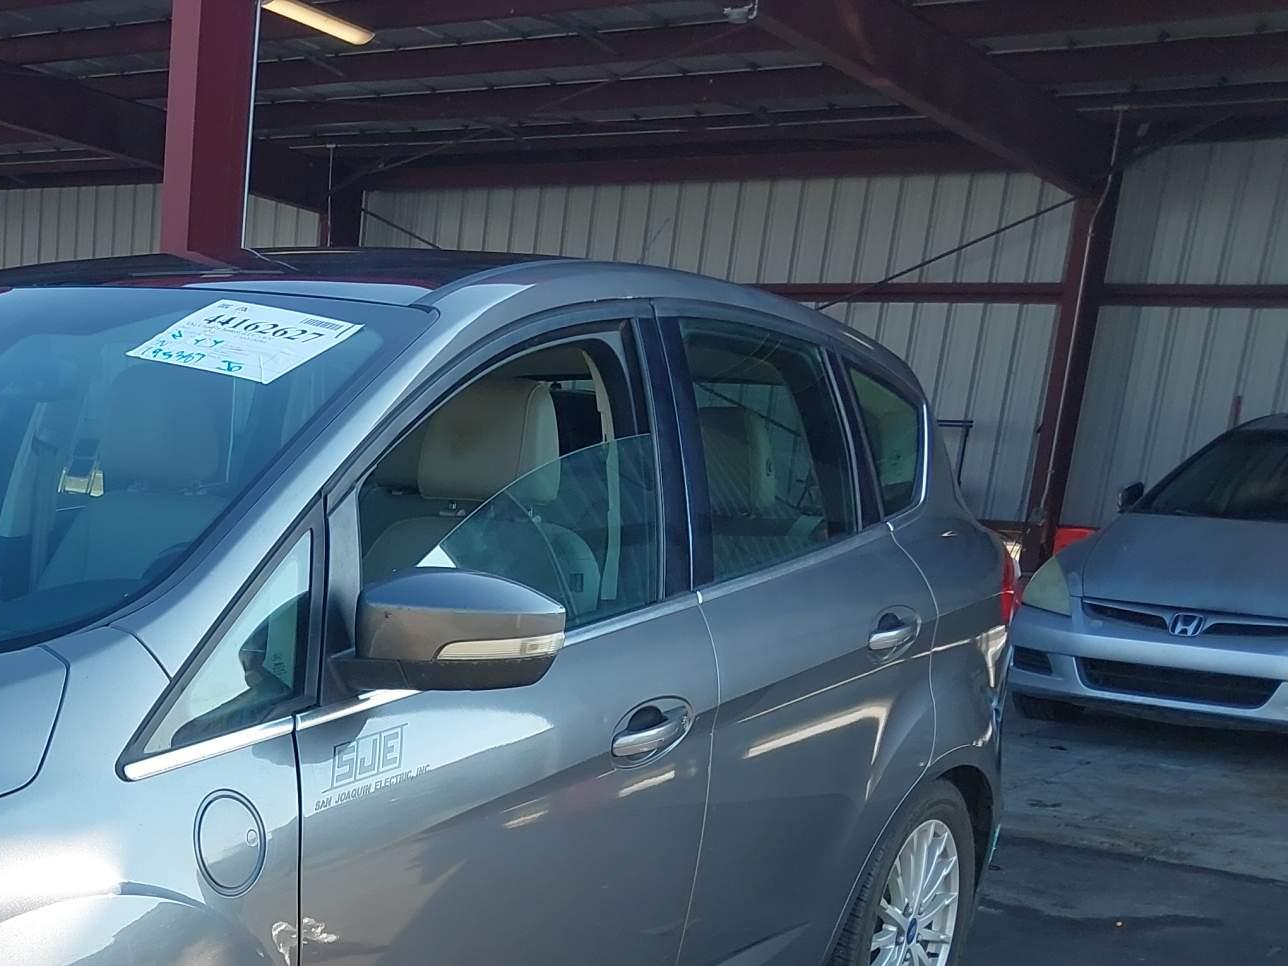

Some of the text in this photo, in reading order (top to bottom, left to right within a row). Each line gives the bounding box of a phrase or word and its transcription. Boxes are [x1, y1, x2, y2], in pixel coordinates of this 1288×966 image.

[204, 313, 326, 344] 44162627
[333, 725, 404, 789] SJE
[315, 796, 332, 811] SAN
[335, 783, 372, 804] JOAQUIN
